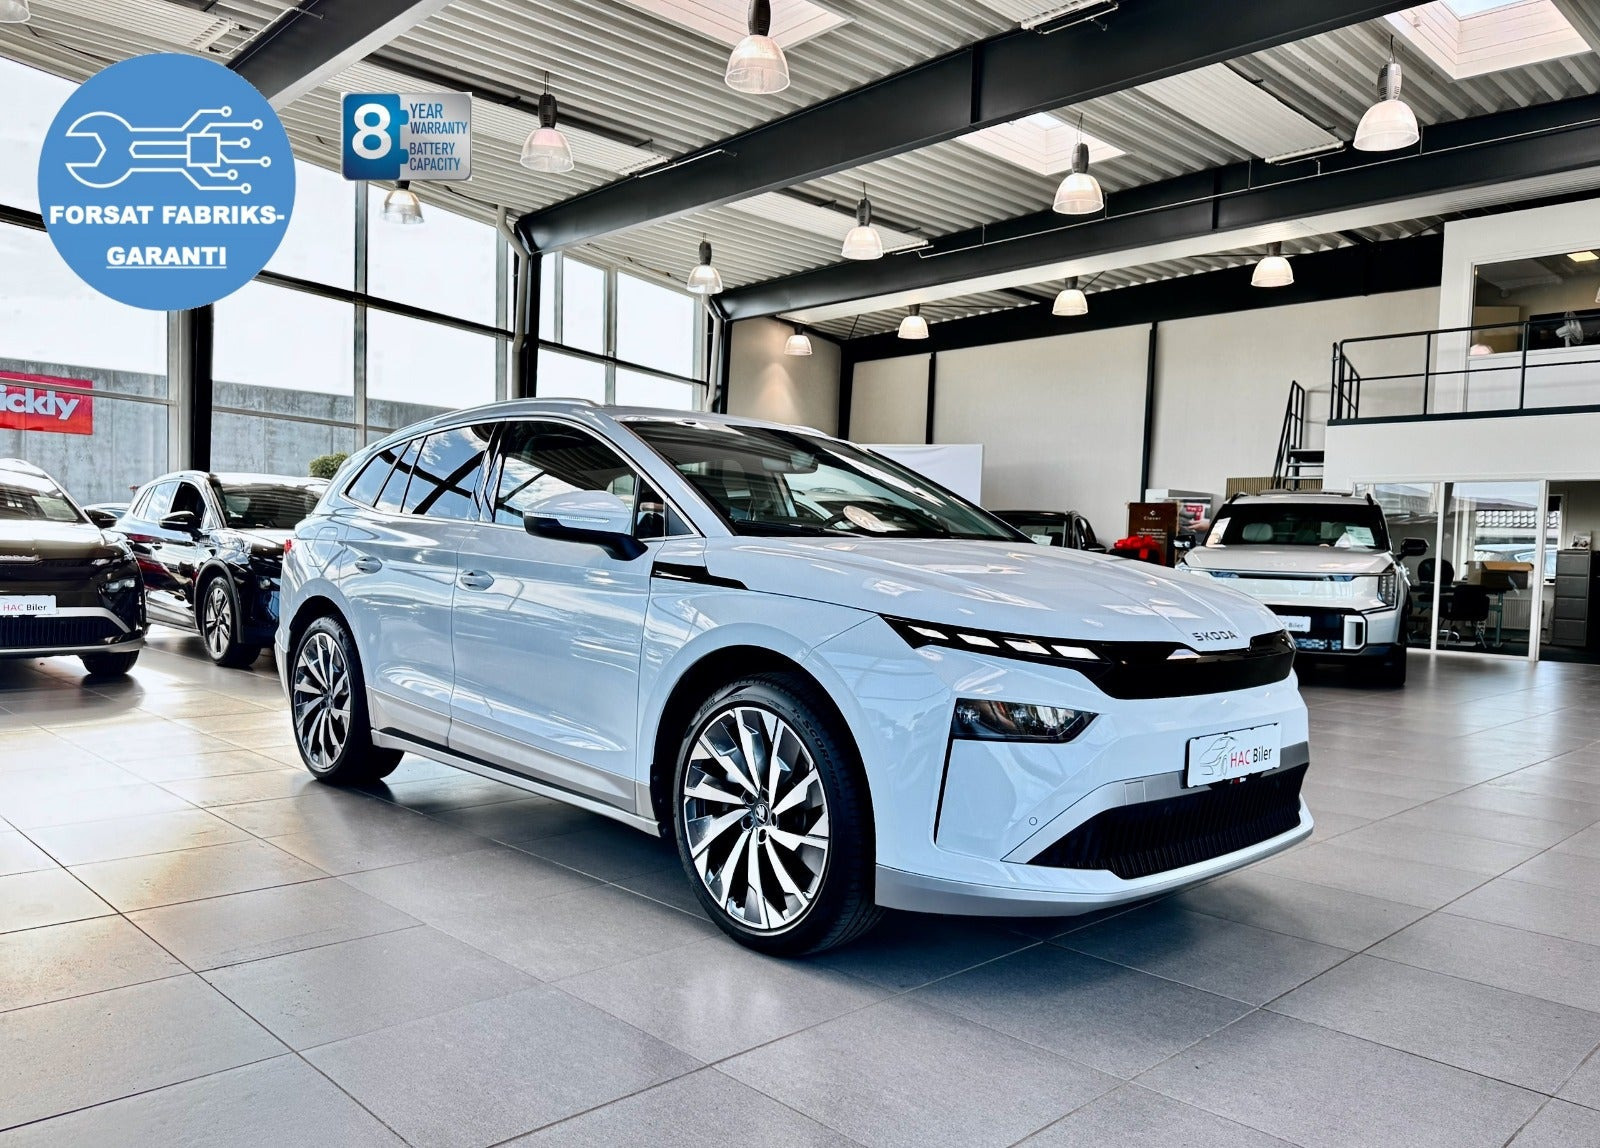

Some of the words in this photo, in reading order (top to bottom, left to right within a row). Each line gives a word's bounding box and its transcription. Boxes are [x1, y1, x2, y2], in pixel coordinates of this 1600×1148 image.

[26, 603, 47, 611] Biler
[1230, 749, 1251, 768] HAC
[1253, 745, 1272, 763] Biler
